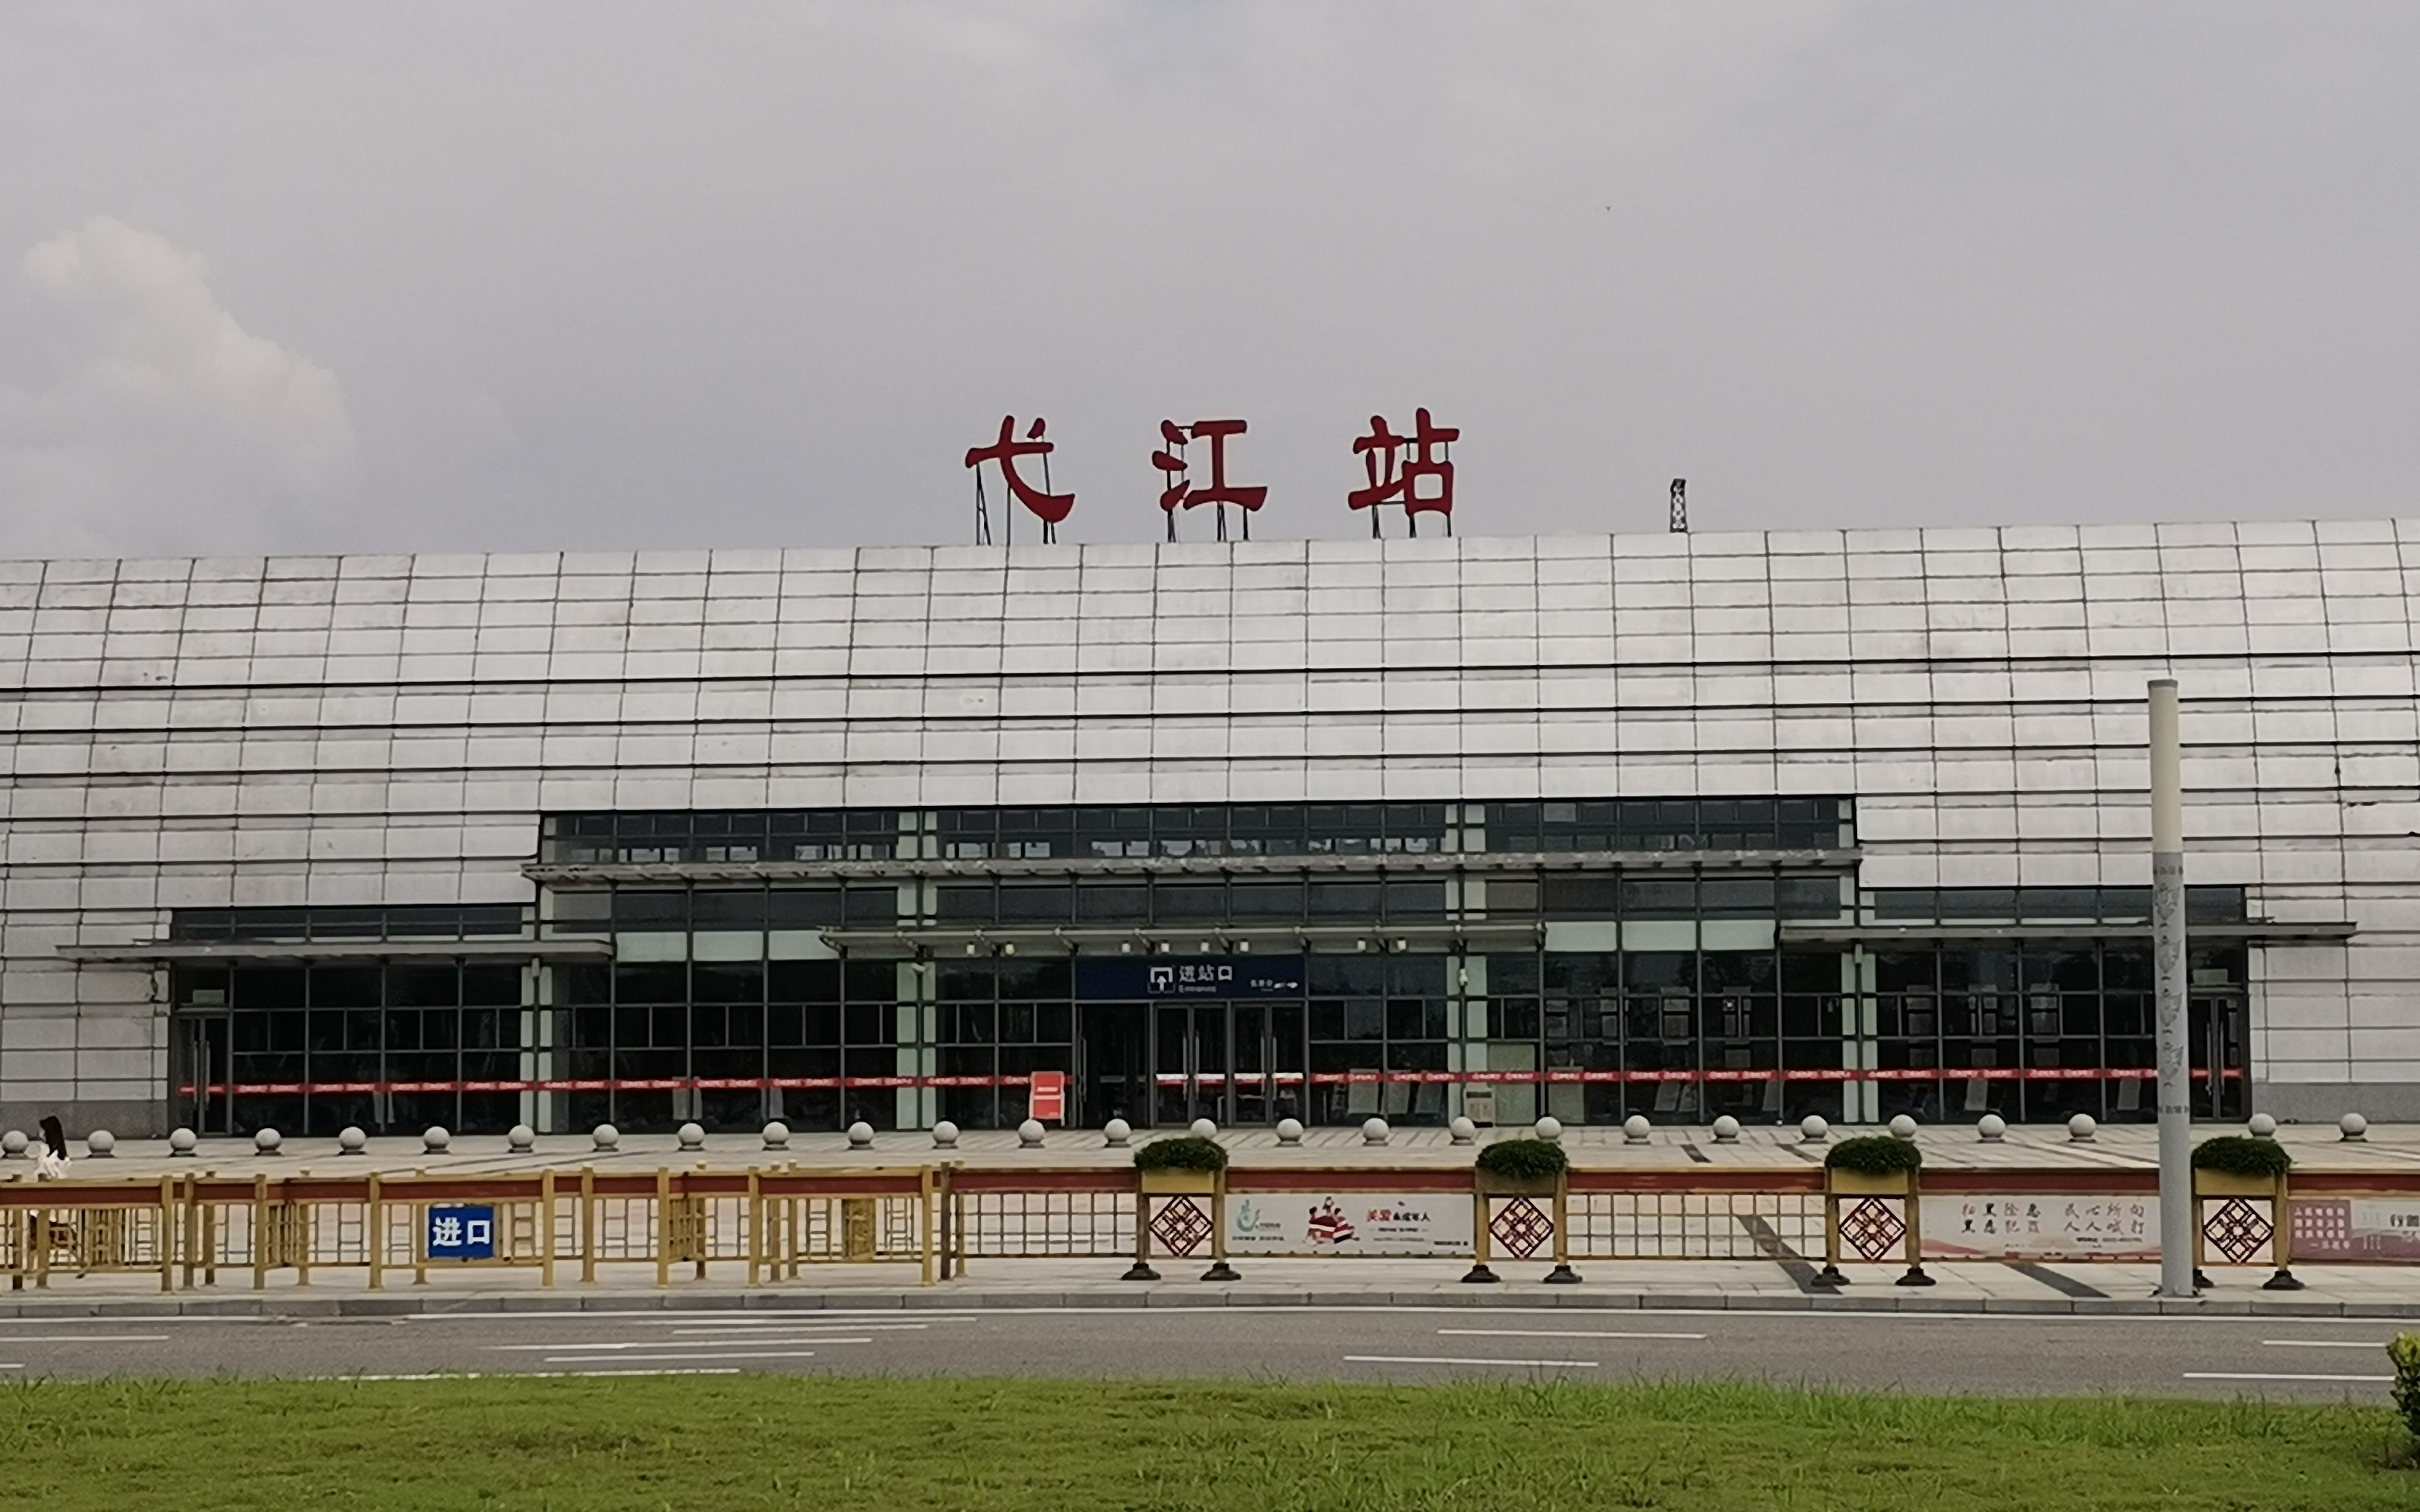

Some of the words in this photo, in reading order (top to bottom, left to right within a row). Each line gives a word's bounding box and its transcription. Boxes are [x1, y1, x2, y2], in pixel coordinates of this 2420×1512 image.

[966, 407, 1460, 523] 弋江站
[1179, 964, 1232, 982] 进站口
[433, 1216, 490, 1246] 进口
